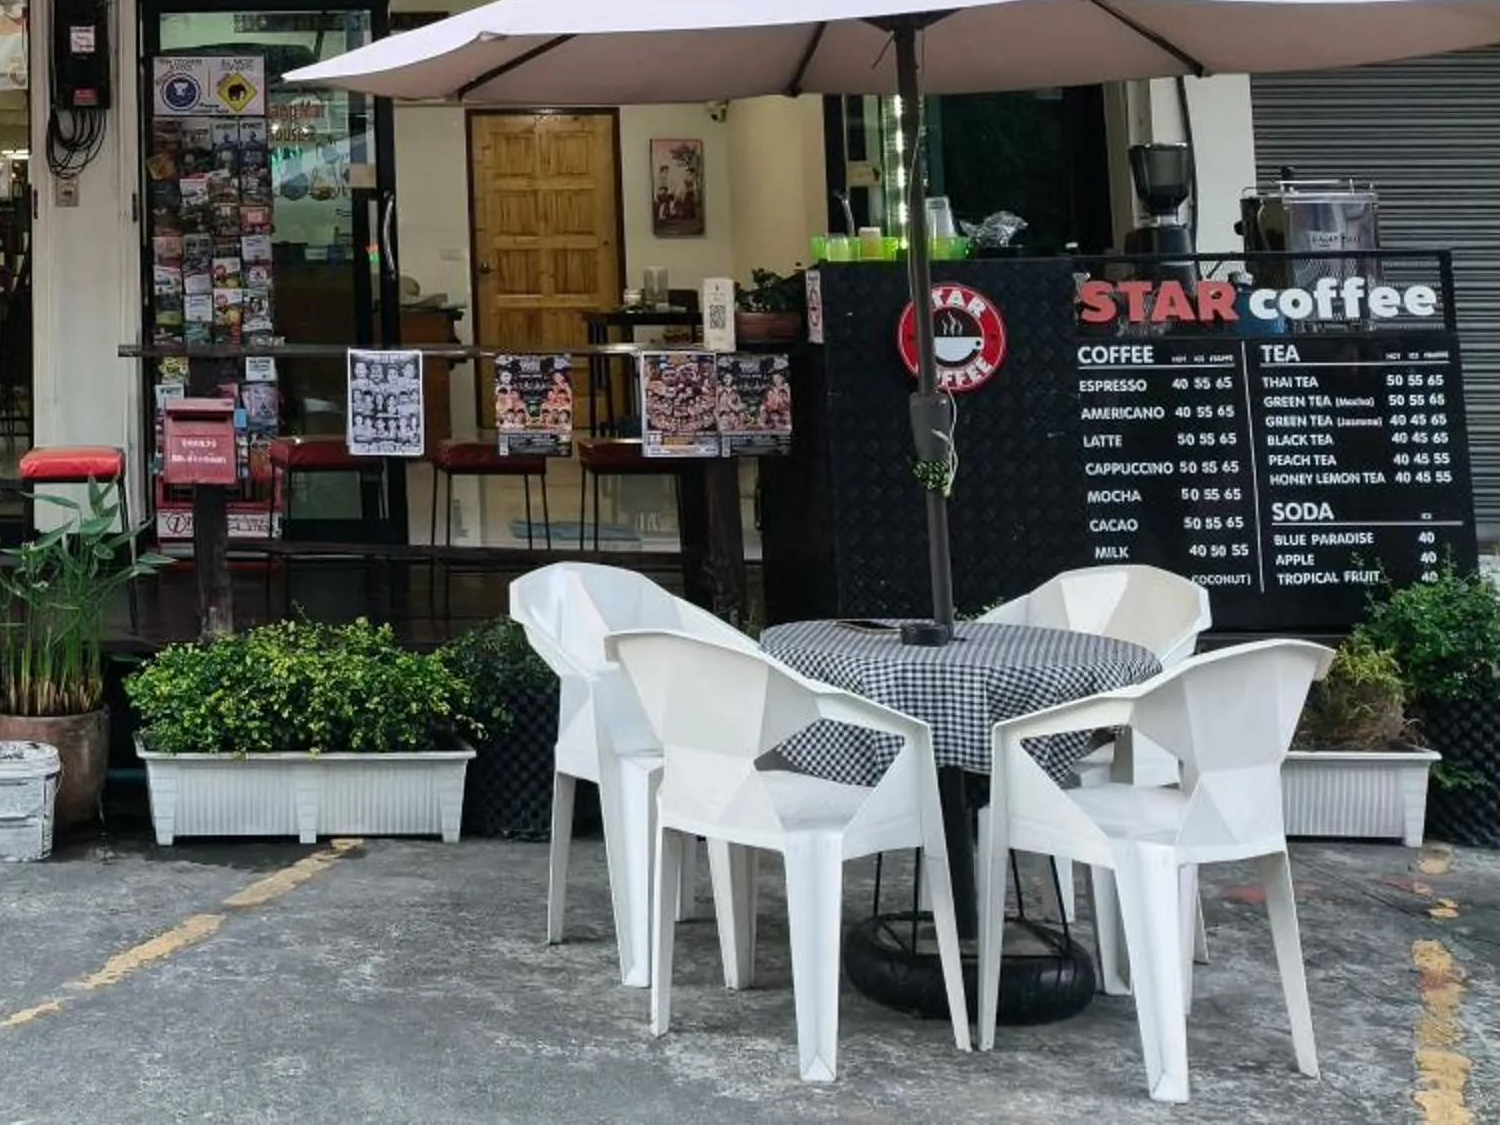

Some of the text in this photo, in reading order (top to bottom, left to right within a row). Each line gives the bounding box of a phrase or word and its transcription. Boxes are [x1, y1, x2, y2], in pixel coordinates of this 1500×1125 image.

[1081, 277, 1438, 323] STAR coffee
[1077, 346, 1155, 364] COFFEE
[1260, 344, 1300, 362] TEA
[1079, 379, 1147, 392] ESPRESSO
[1172, 378, 1189, 390] 40
[1215, 376, 1233, 389] 65
[1262, 375, 1444, 388] THAI TEA 50 55 65
[1263, 396, 1306, 407] GREEN
[1308, 396, 1332, 407] TEA
[1388, 395, 1405, 406] 50
[1409, 395, 1425, 406] 55
[1081, 405, 1235, 420] AMERICANO 40 55 65
[1265, 416, 1307, 427] GREEN
[1311, 415, 1333, 427] TEA
[1389, 414, 1406, 426] 40
[1410, 414, 1427, 426] 45
[1430, 414, 1447, 426] 65
[1083, 433, 1237, 448] LATTE 50 55 65
[1267, 432, 1449, 446] BLACK TEA 40 45 65
[1268, 453, 1451, 466] PEACH TEA 40 45 55
[1085, 462, 1174, 476] CAPPUCCINO
[1179, 461, 1197, 474] 50
[1221, 461, 1239, 473] 65
[1269, 471, 1452, 486] HONEY LEMON TEA 40 45 55
[1087, 488, 1242, 503] MOCHA 50 55 65
[1272, 502, 1335, 521] SODA
[1089, 518, 1138, 532] CACAO
[1183, 517, 1201, 530] 50
[1226, 516, 1244, 528] 65
[1274, 531, 1435, 546] BLUE PARADISE 40
[1095, 544, 1249, 559] MILK 40 50 55
[1276, 552, 1437, 565] APPLE 40
[1278, 570, 1438, 585] TROPICAL FRUIT 40
